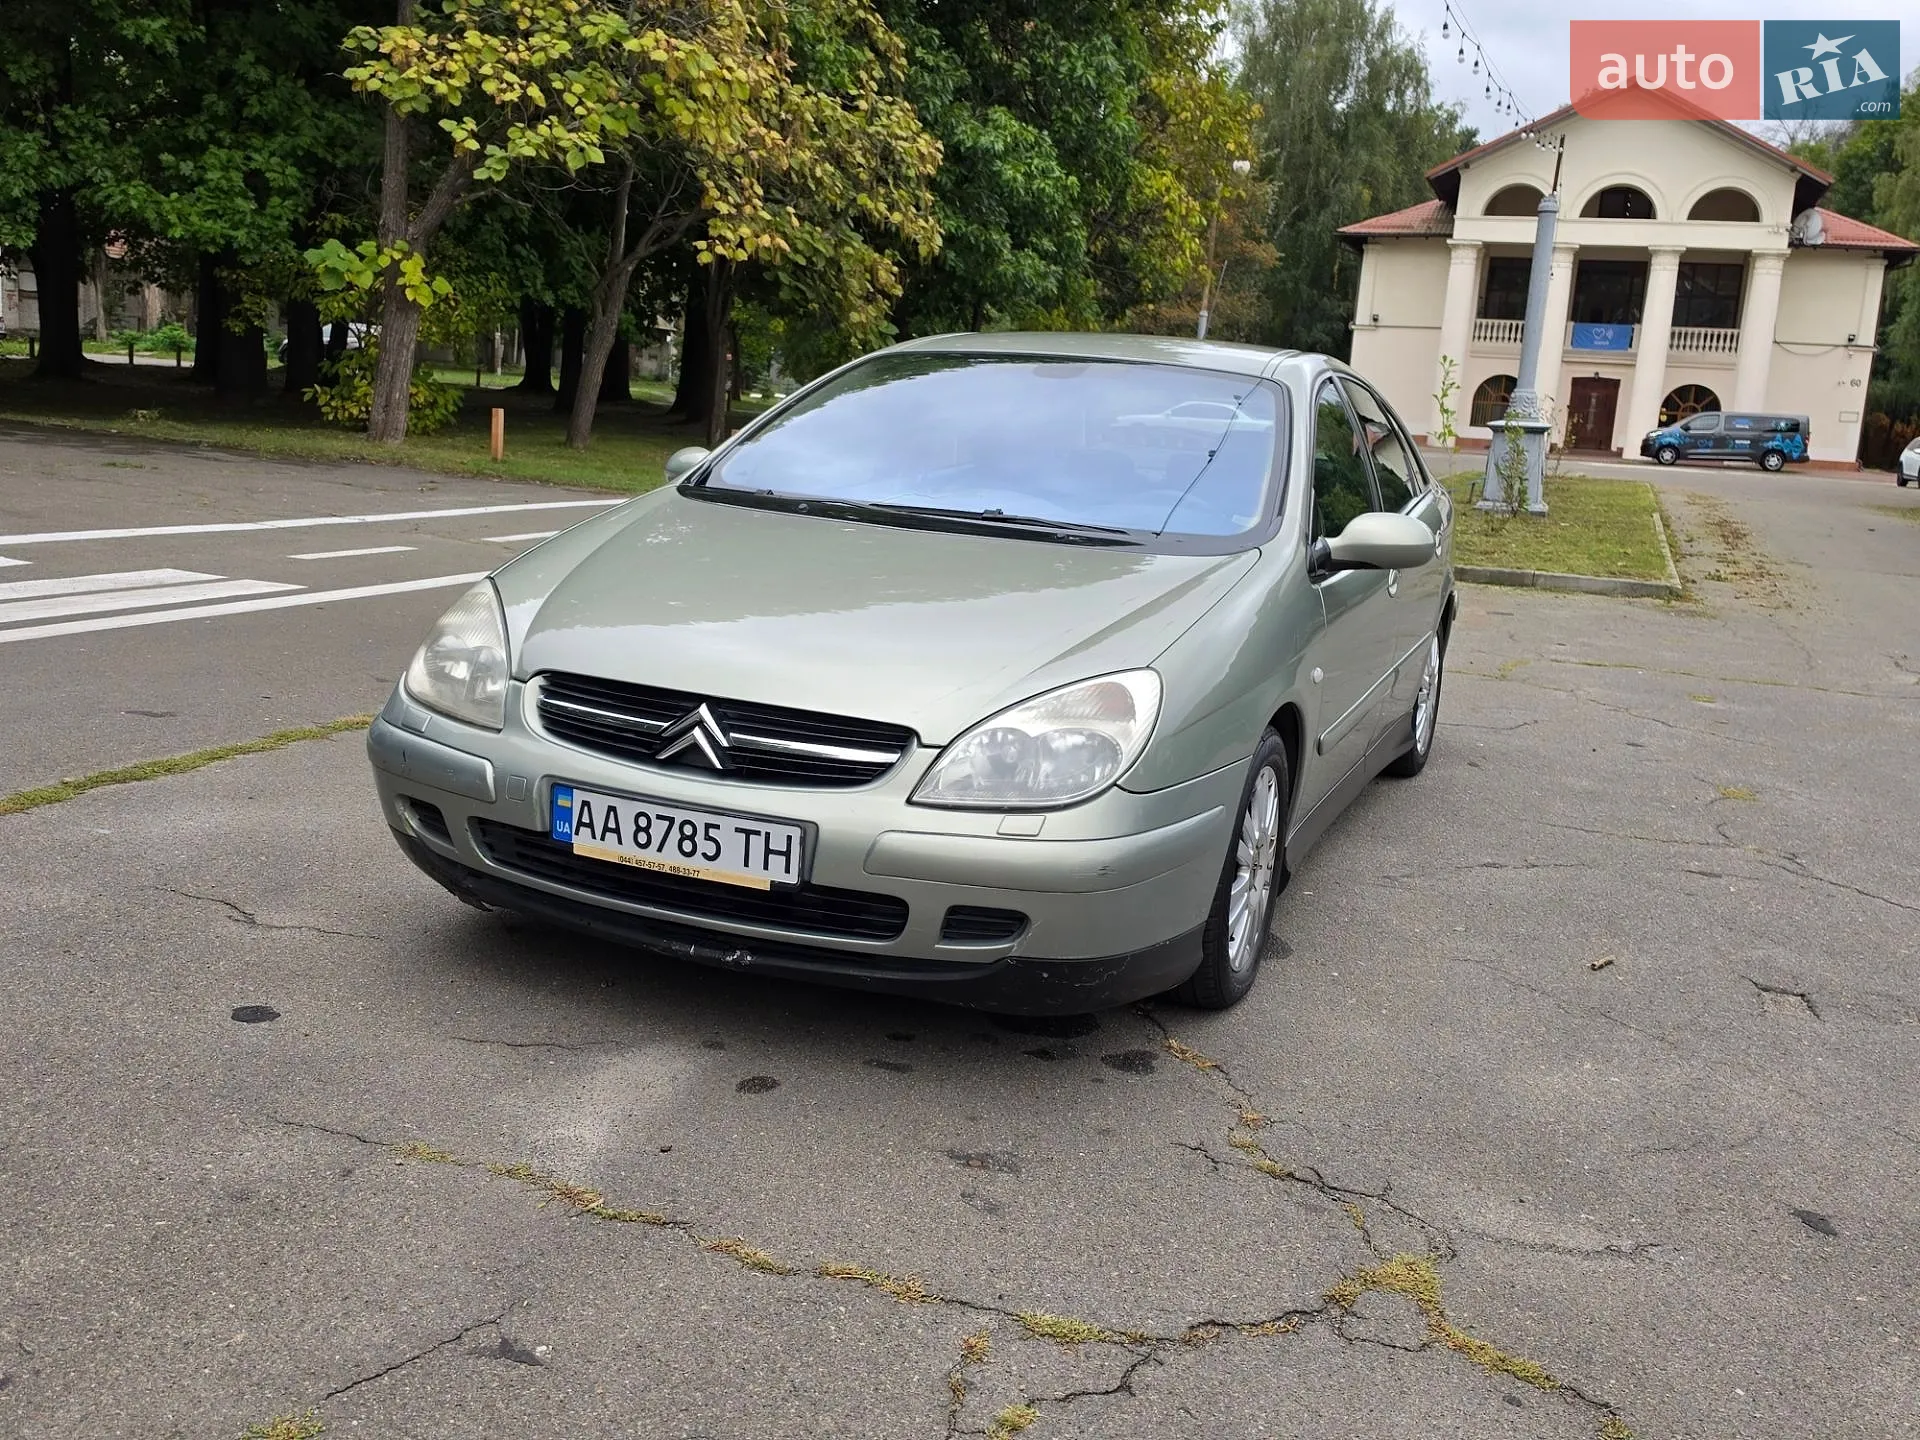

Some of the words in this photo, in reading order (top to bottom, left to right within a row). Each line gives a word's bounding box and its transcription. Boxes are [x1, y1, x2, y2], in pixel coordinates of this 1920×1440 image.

[556, 820, 571, 834] UA
[574, 799, 624, 846] AA
[632, 811, 722, 862] 8785
[734, 826, 793, 874] TH
